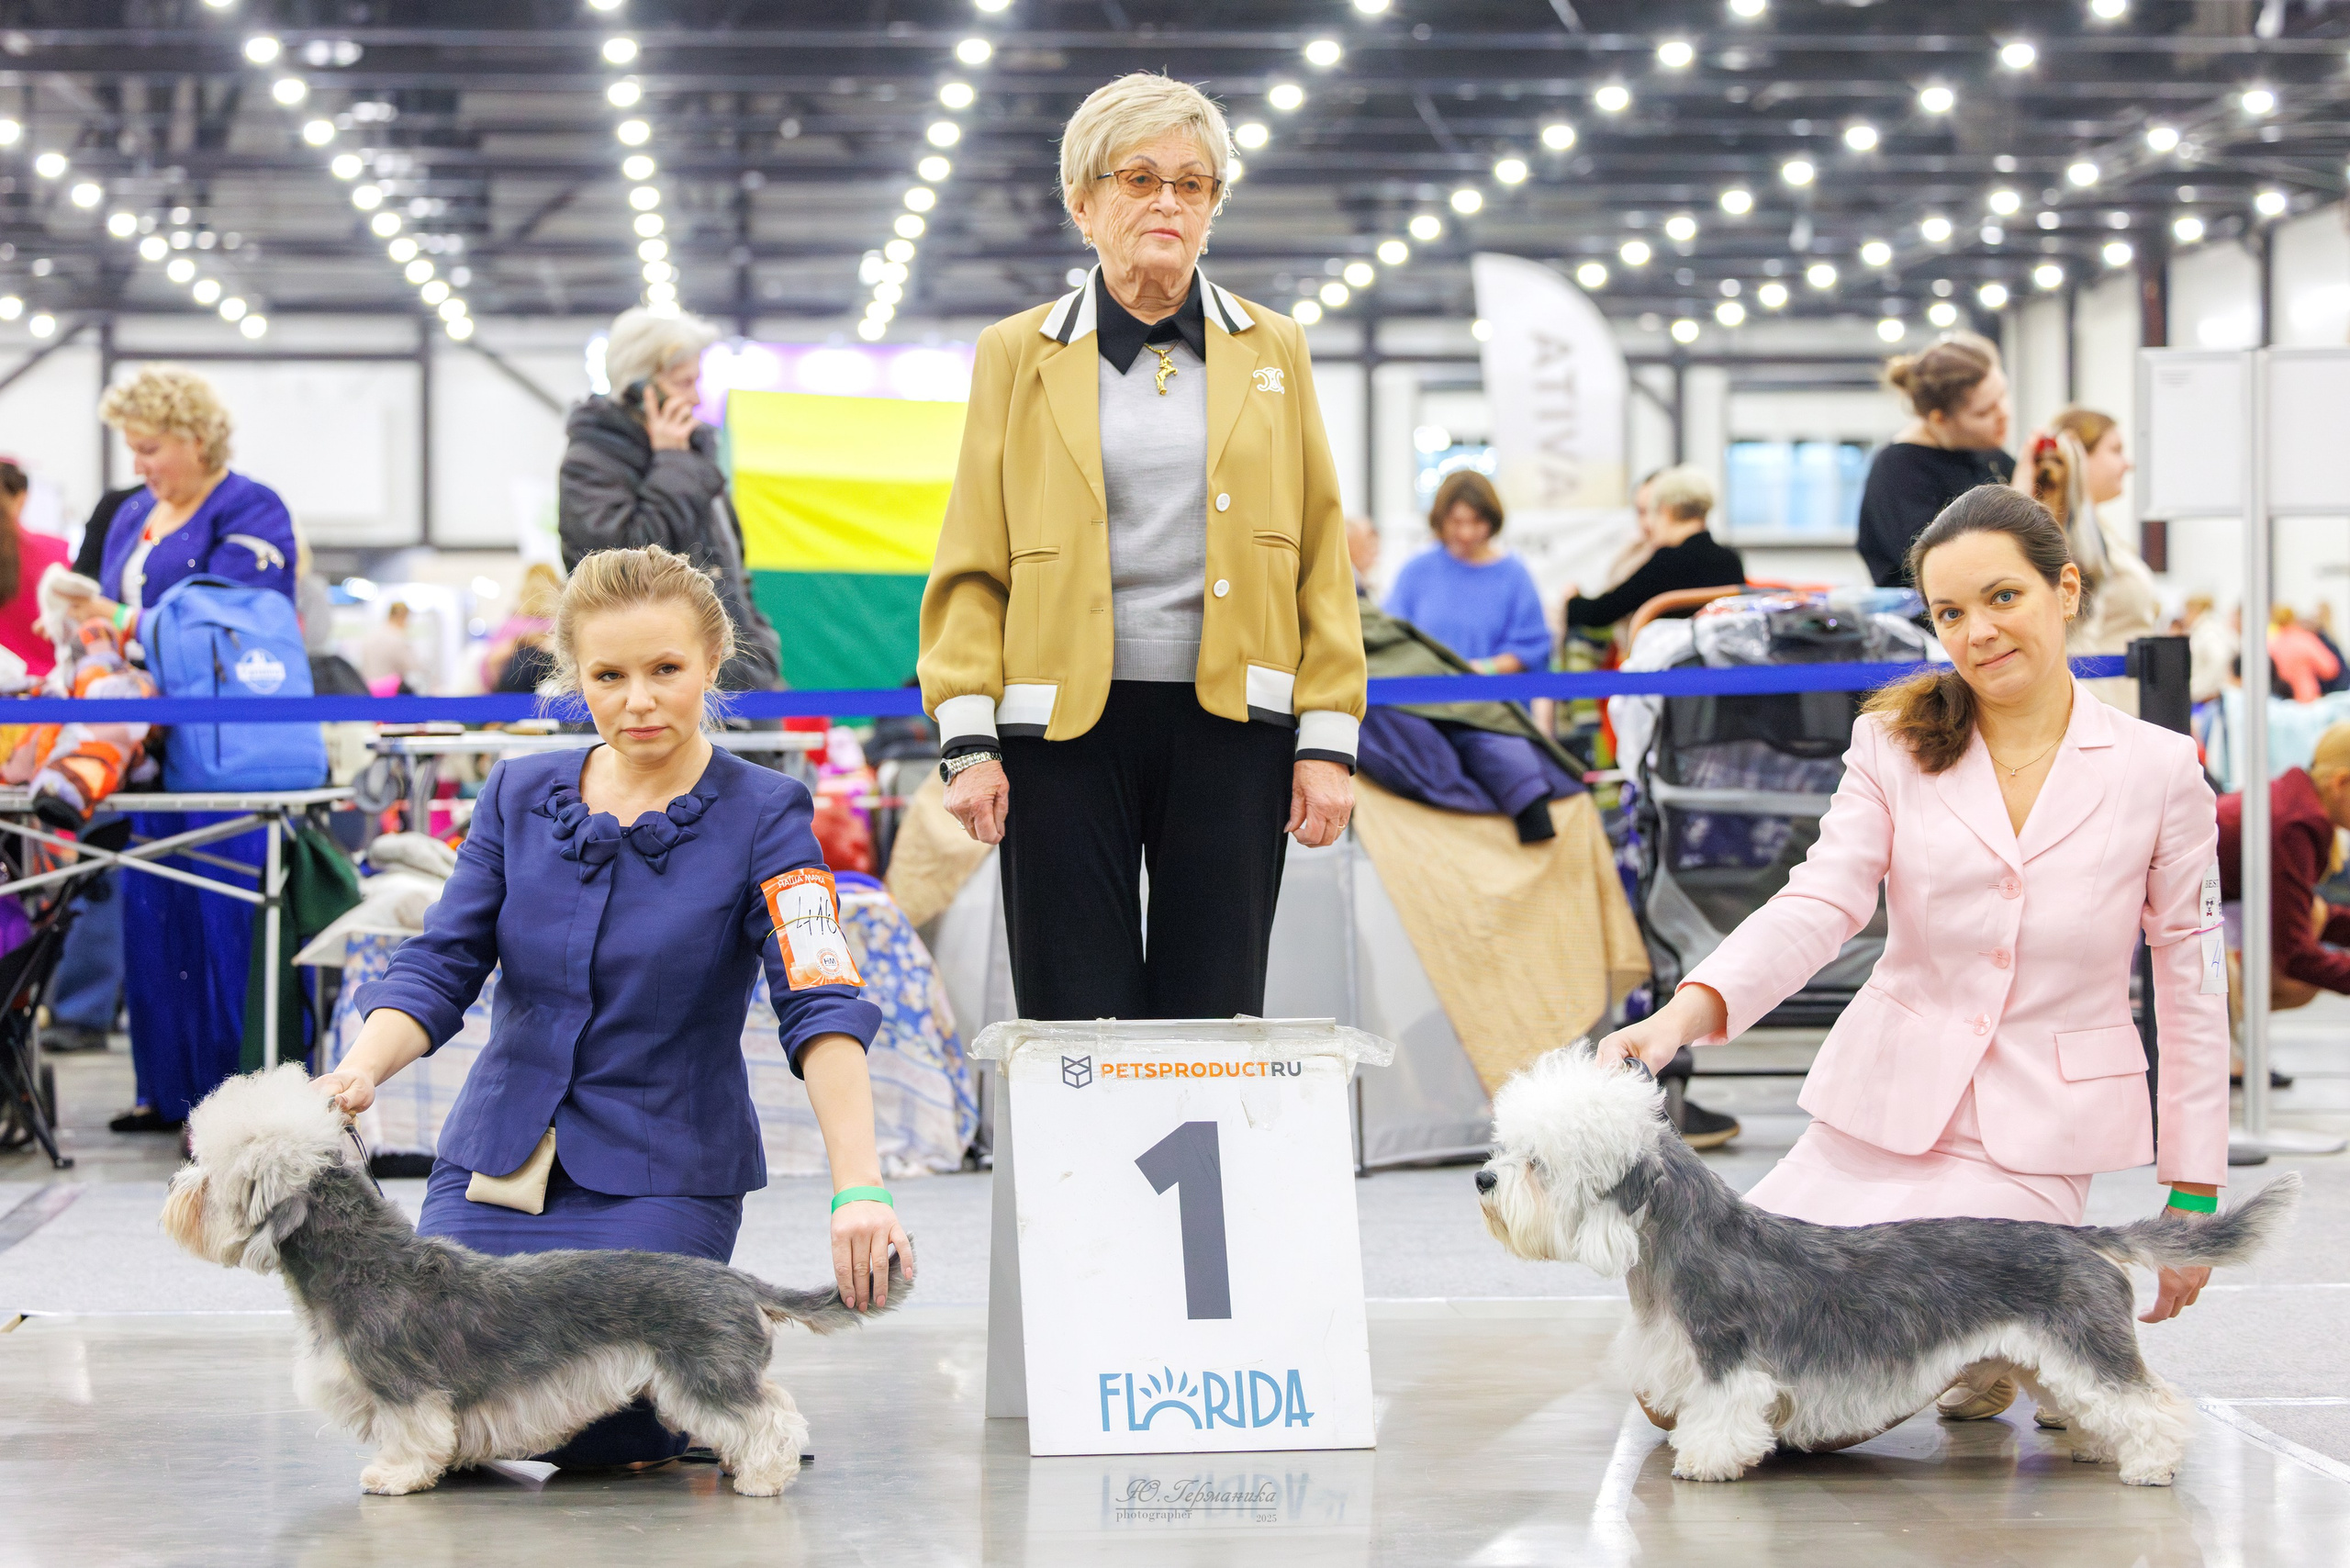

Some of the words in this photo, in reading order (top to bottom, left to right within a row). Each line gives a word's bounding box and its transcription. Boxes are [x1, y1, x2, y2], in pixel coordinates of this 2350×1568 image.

[778, 873, 803, 889] НАША
[1134, 1120, 1232, 1320] 1
[1099, 1366, 1315, 1432] FLORIDA
